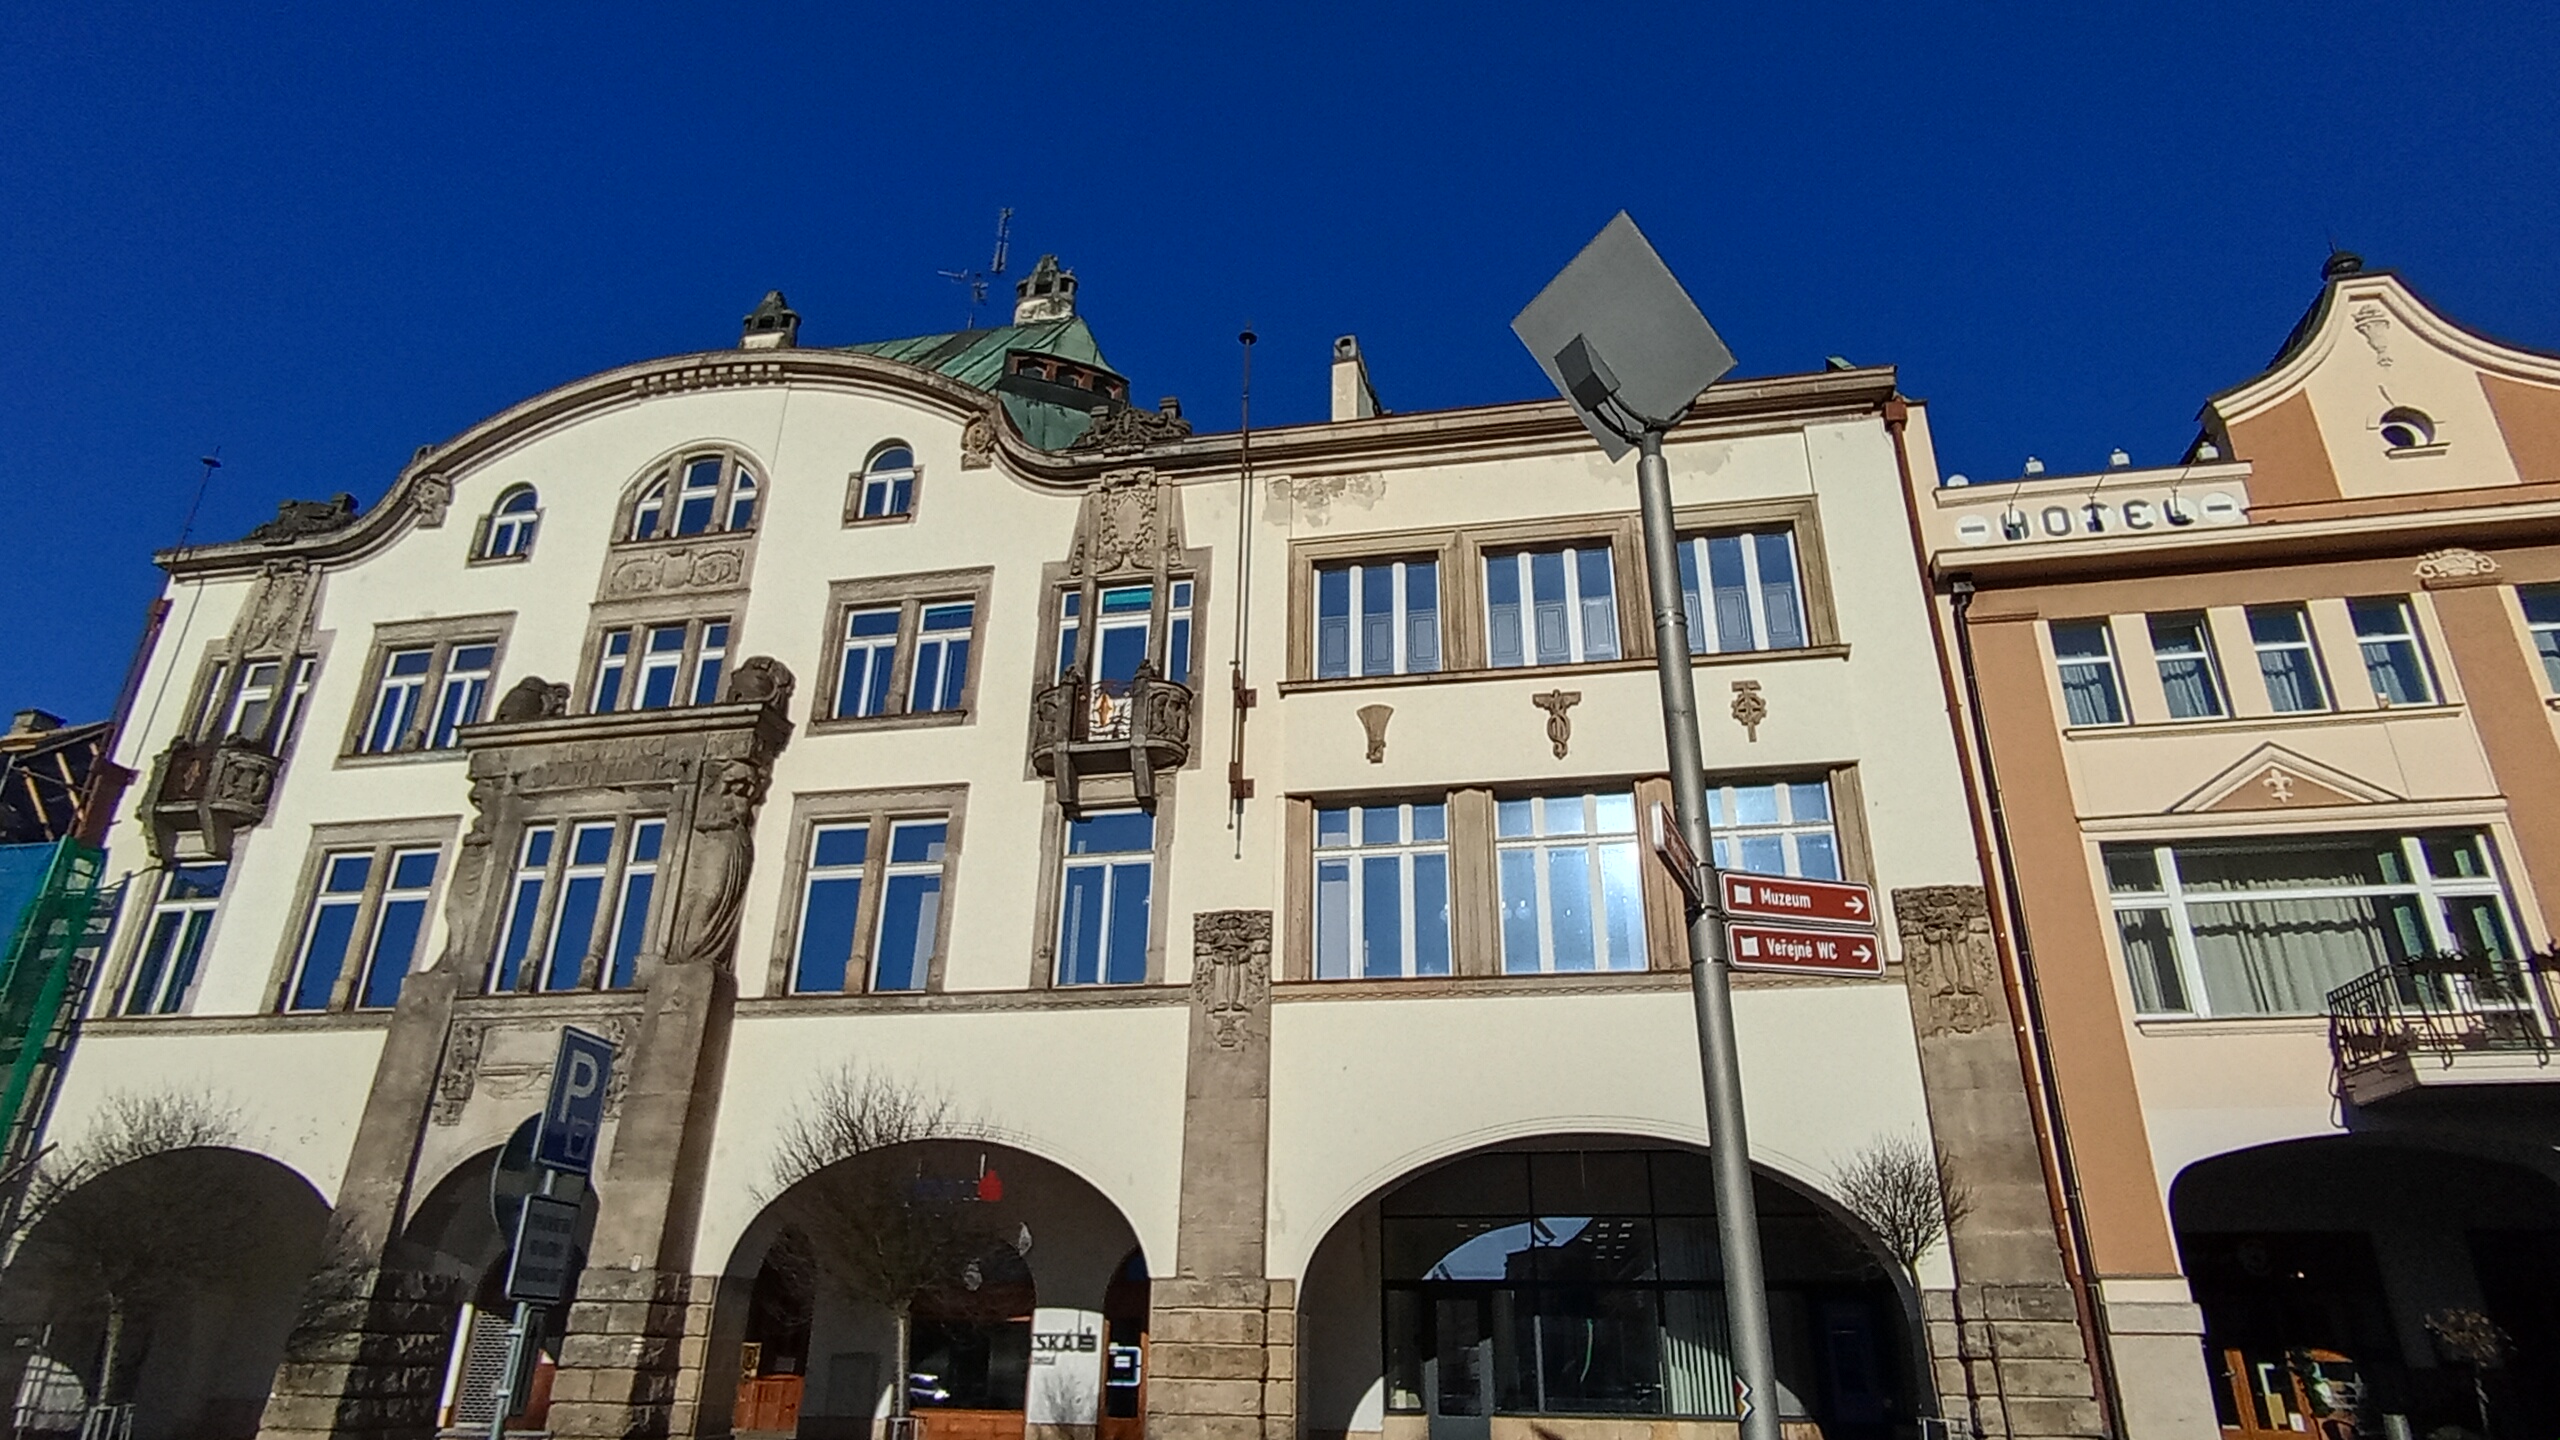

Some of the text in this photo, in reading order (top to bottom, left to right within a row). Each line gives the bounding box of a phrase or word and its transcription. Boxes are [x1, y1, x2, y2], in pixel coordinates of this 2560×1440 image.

[2000, 498, 2195, 541] HOTEL
[1759, 887, 1812, 909] Muzeum
[1766, 938, 1838, 961] Veřejné WC
[557, 1049, 599, 1124] P
